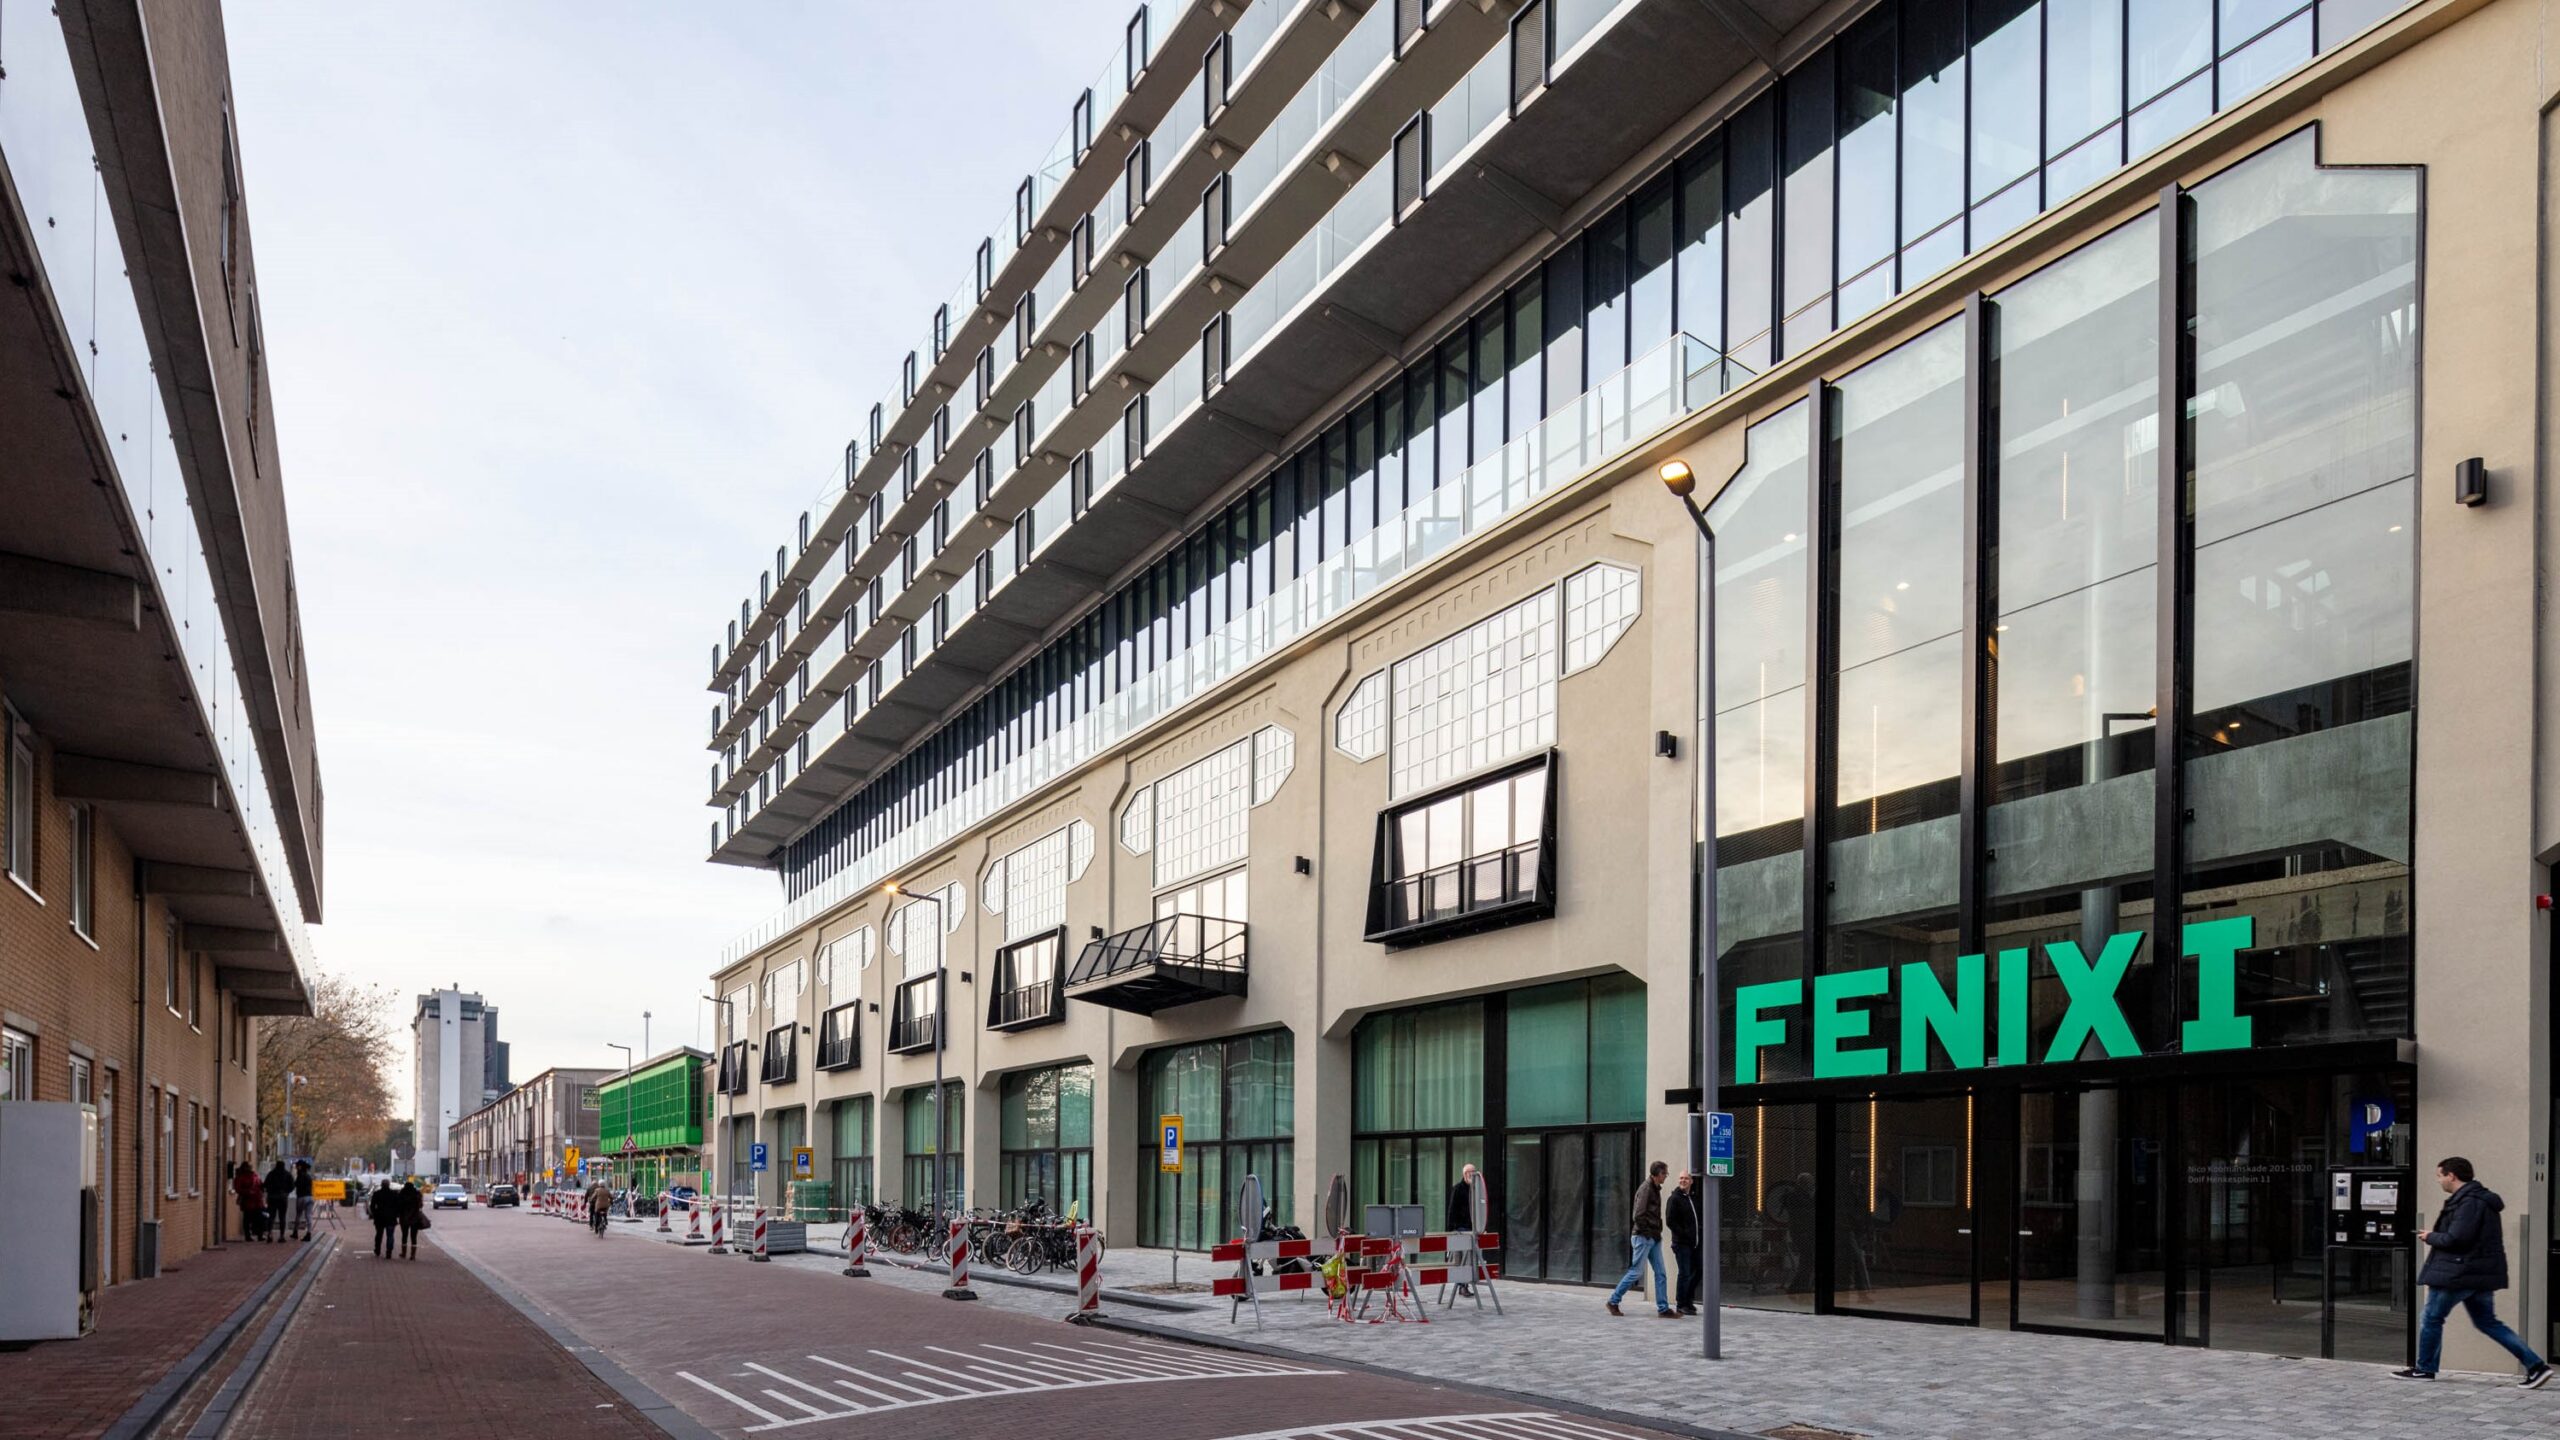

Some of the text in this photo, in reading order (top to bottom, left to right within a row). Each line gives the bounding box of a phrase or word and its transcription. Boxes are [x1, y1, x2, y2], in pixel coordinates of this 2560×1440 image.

[1736, 915, 2256, 1086] FENIX I
[1711, 1115, 1720, 1135] P
[2350, 1098, 2396, 1152] P
[1167, 1128, 1175, 1146] P
[753, 1145, 764, 1160] P
[799, 1154, 807, 1164] P
[2208, 1164, 2267, 1173] Koomanskade
[2269, 1164, 2313, 1173] 201-1020
[2187, 1175, 2271, 1184] Dolf Henkesplein 11
